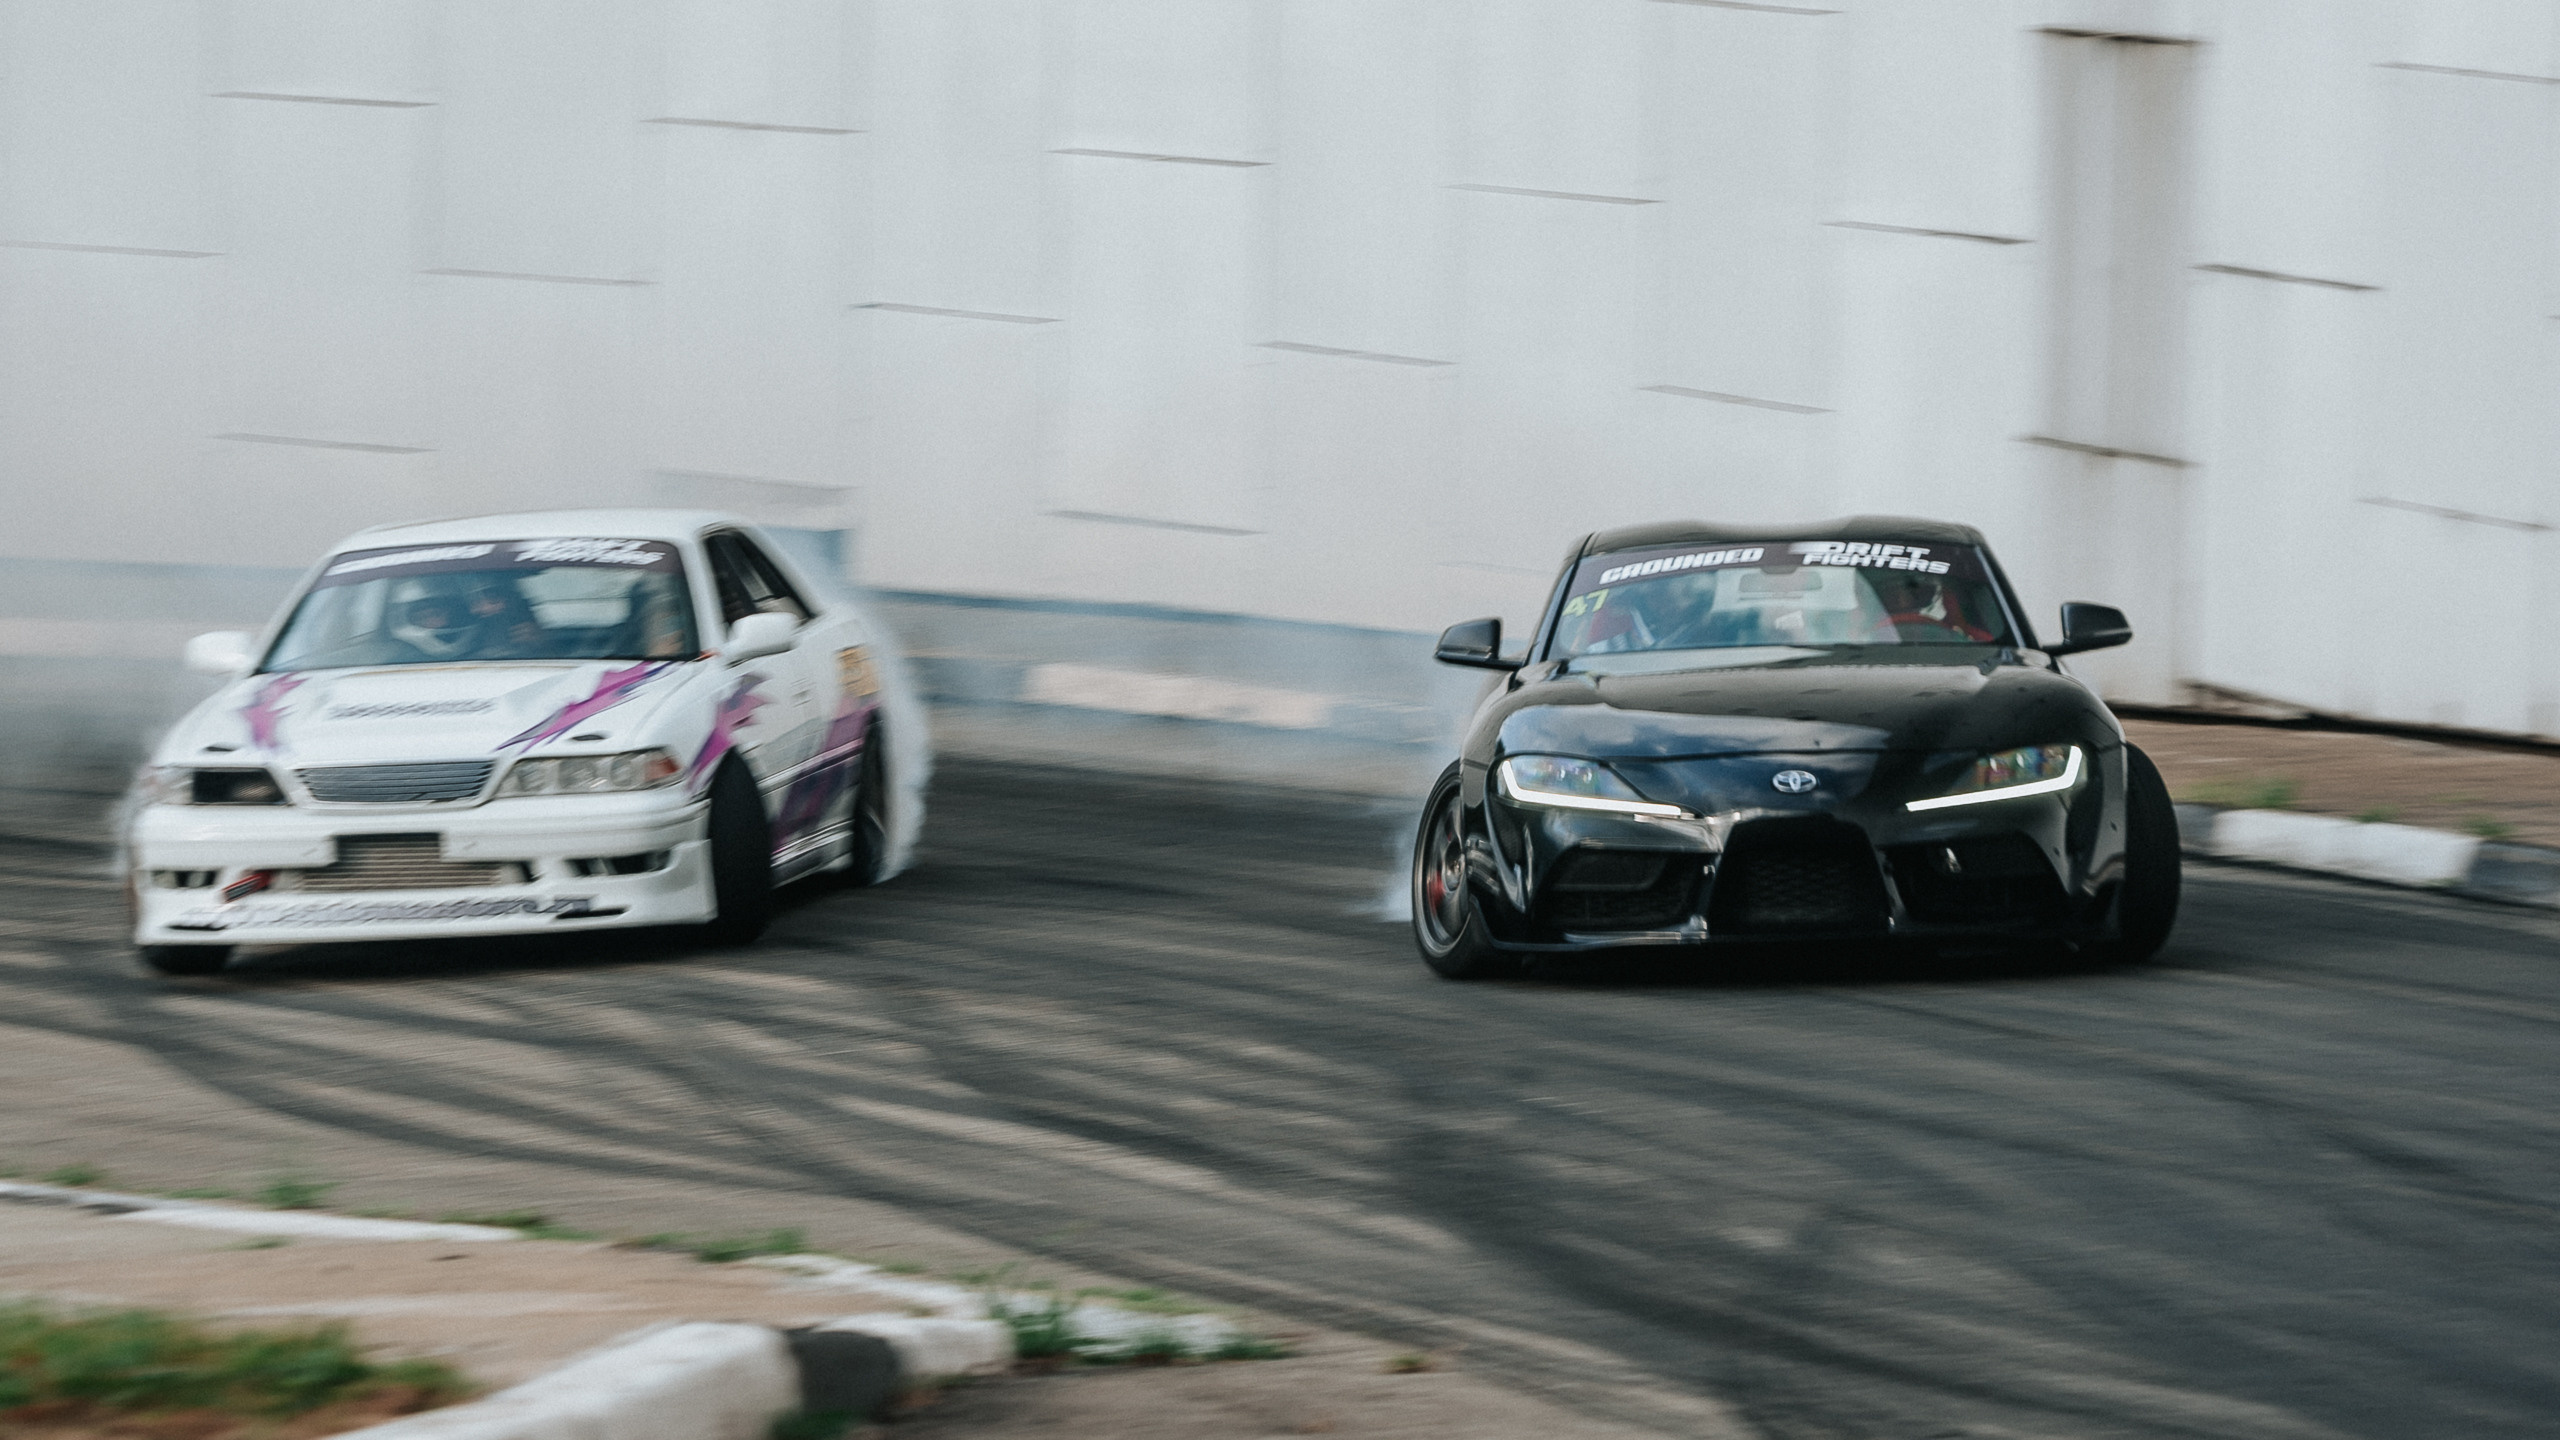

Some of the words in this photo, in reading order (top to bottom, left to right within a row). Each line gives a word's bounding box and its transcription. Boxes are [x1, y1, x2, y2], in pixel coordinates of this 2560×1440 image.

[1789, 540, 1931, 559] DRIFT
[1599, 547, 1765, 585] GROUNDED
[1802, 552, 1951, 575] FIGHTERS
[1562, 588, 1610, 617] 47
